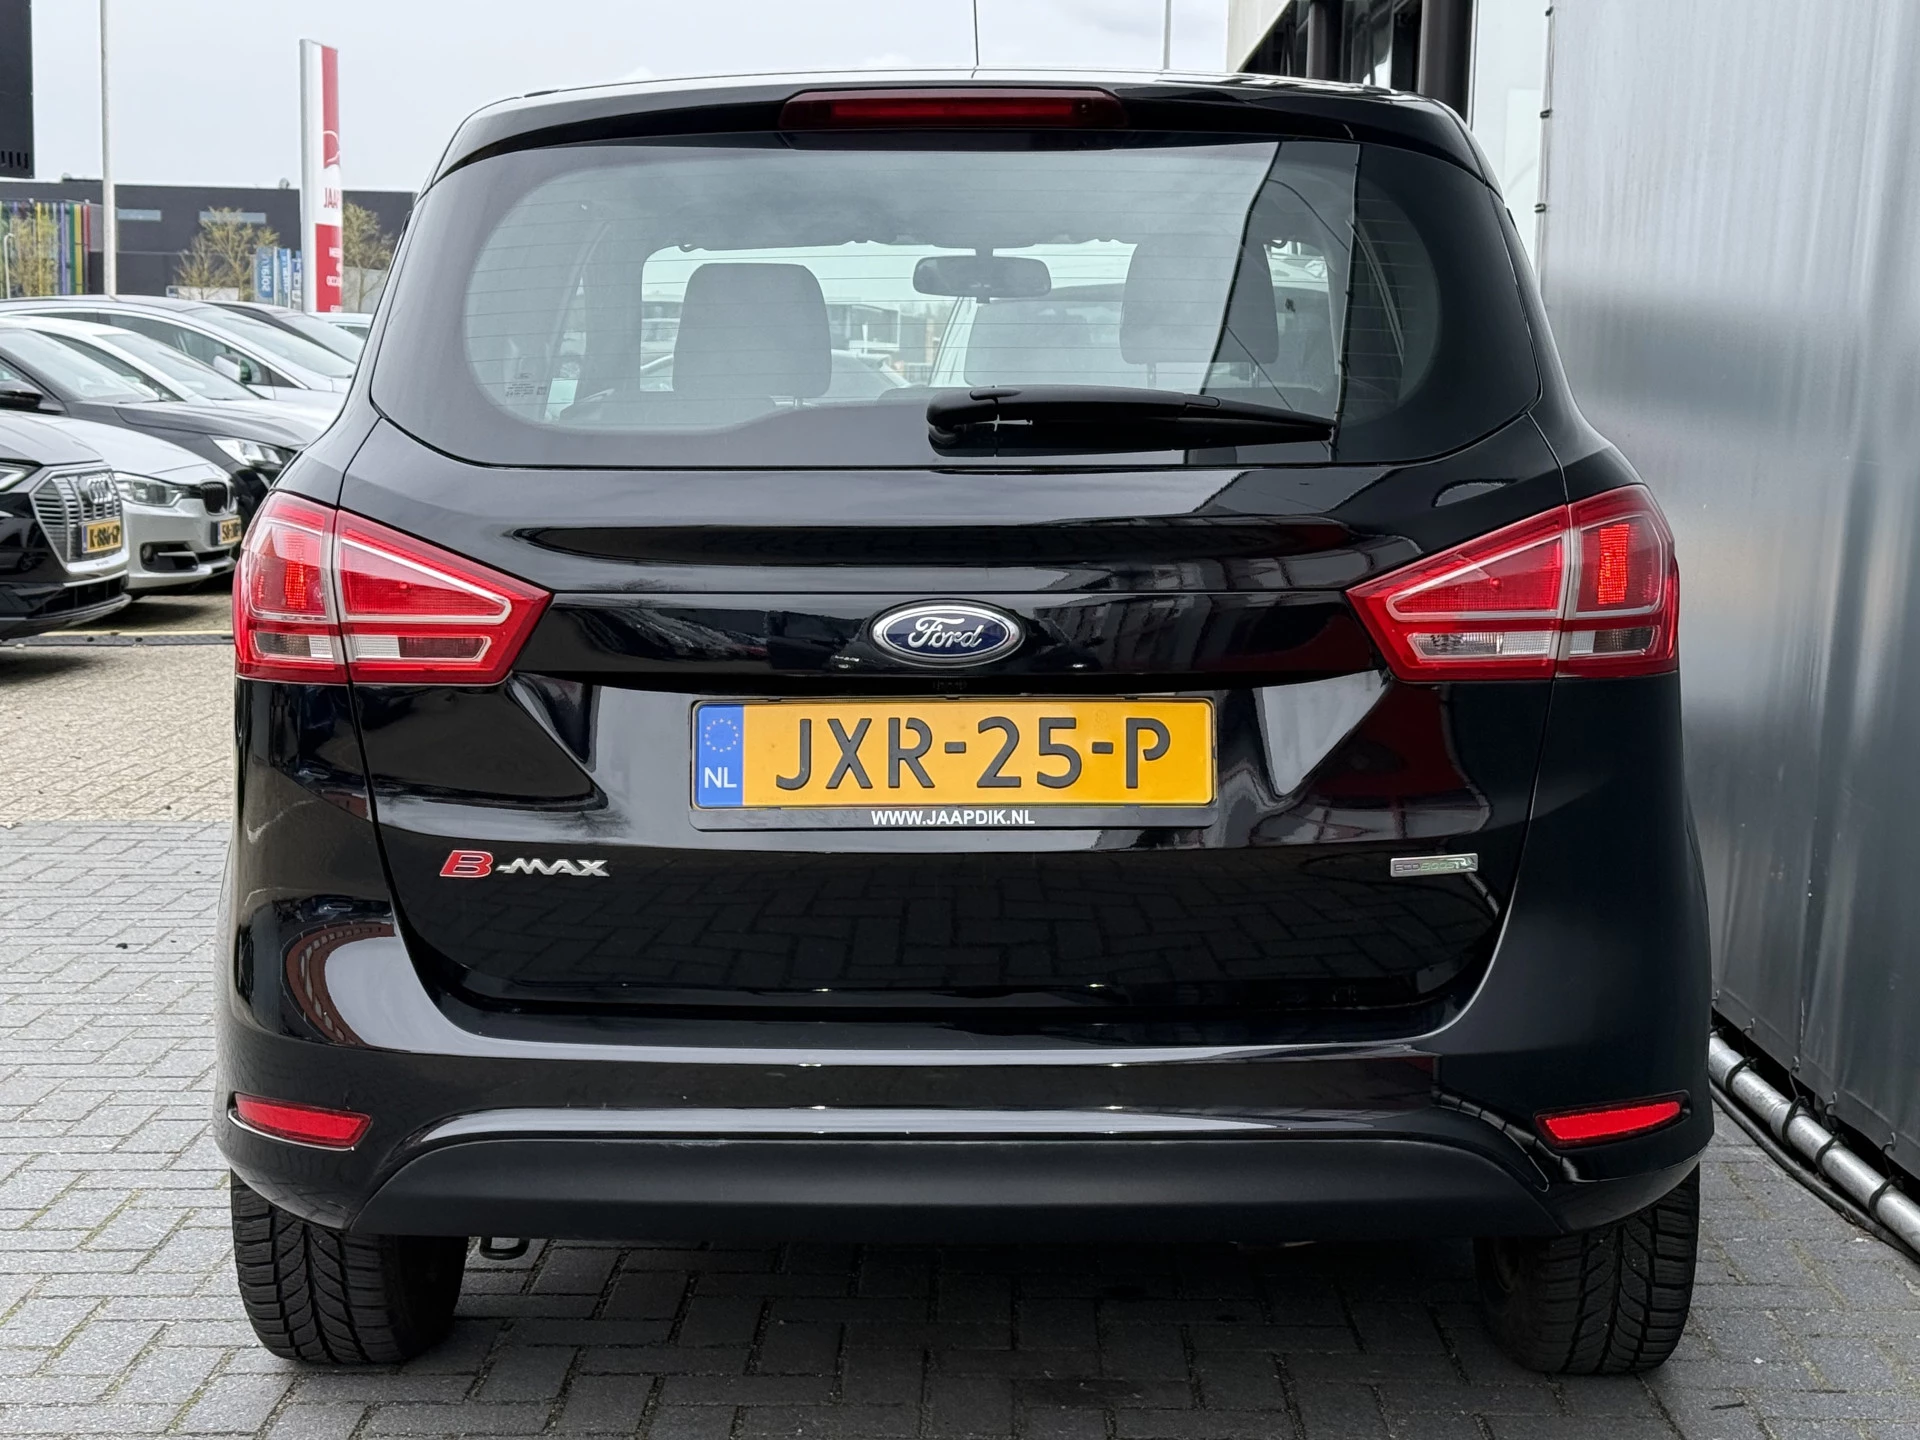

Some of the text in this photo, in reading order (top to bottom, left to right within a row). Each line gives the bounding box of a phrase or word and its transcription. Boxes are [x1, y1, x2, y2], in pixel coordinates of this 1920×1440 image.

[907, 616, 985, 648] Ford
[775, 716, 1171, 791] JXR-25-P
[703, 766, 737, 788] NL
[871, 809, 1036, 826] WWW.JAAPDIK.NL
